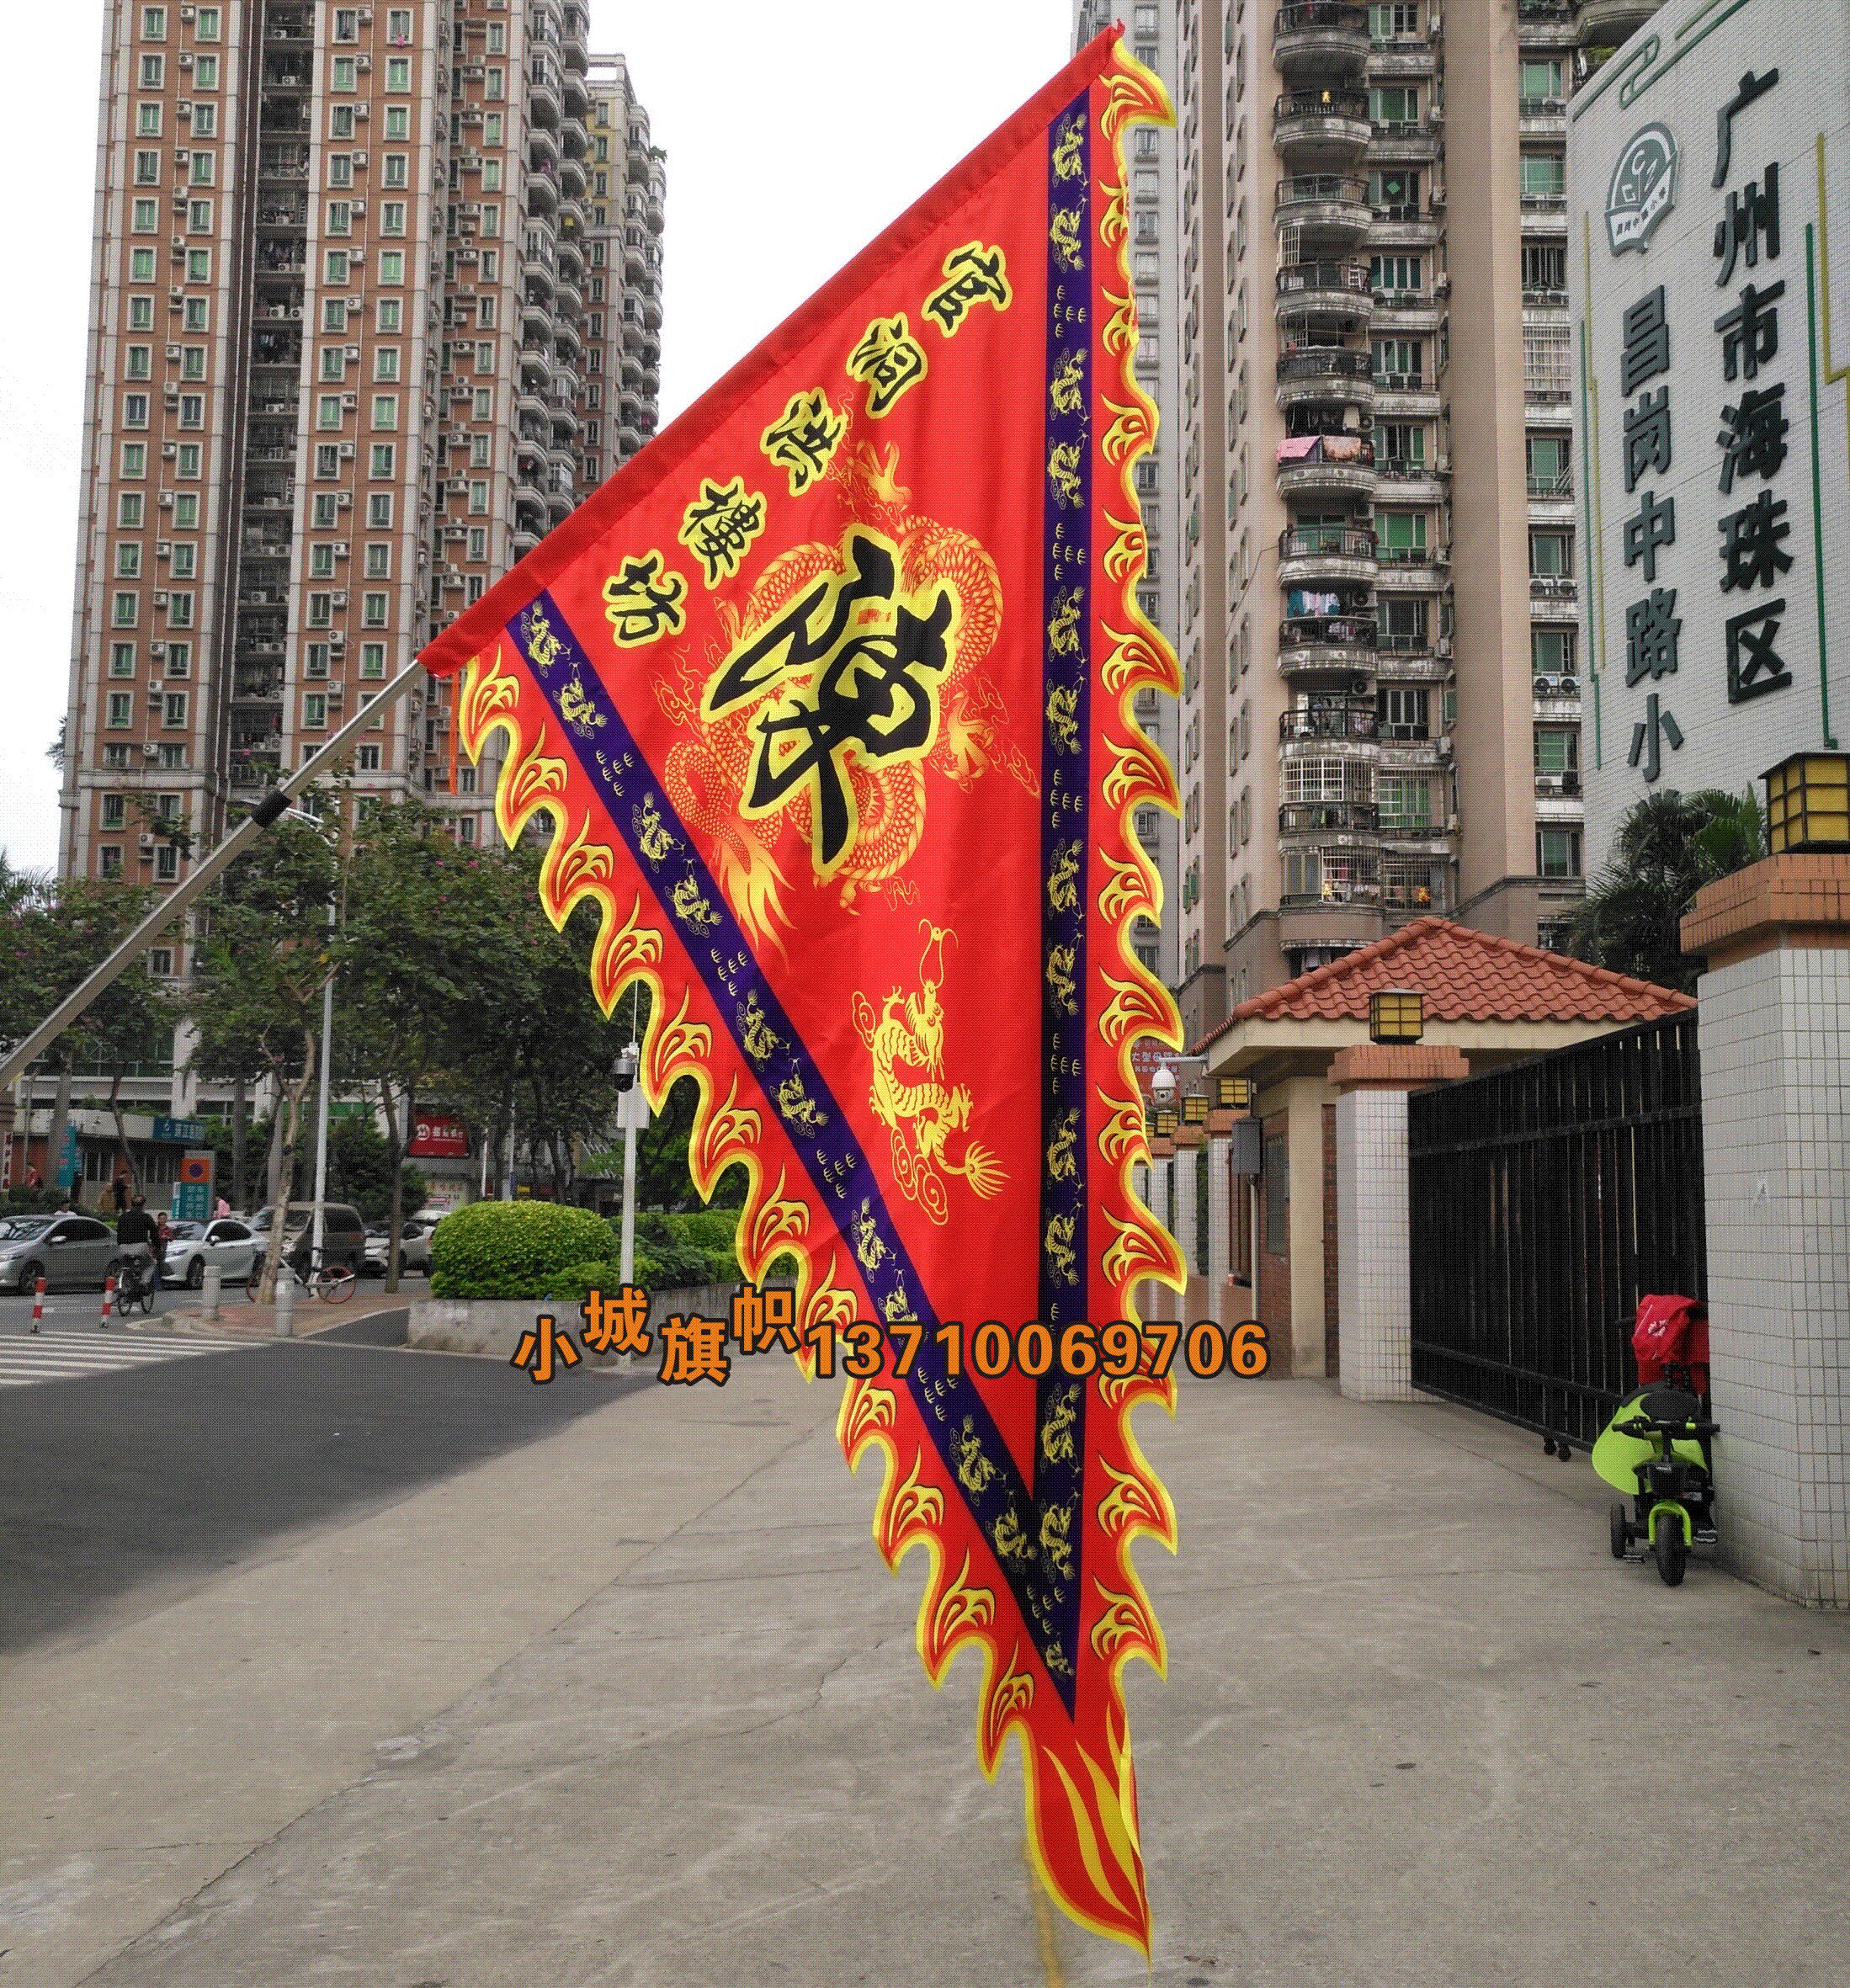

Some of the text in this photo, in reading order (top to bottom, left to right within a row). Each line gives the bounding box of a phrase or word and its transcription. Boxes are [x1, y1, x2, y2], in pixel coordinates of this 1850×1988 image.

[1620, 284, 1684, 801] 昌岗中路小
[1712, 67, 1794, 704] 广州市海珠区
[707, 530, 957, 867] 陳
